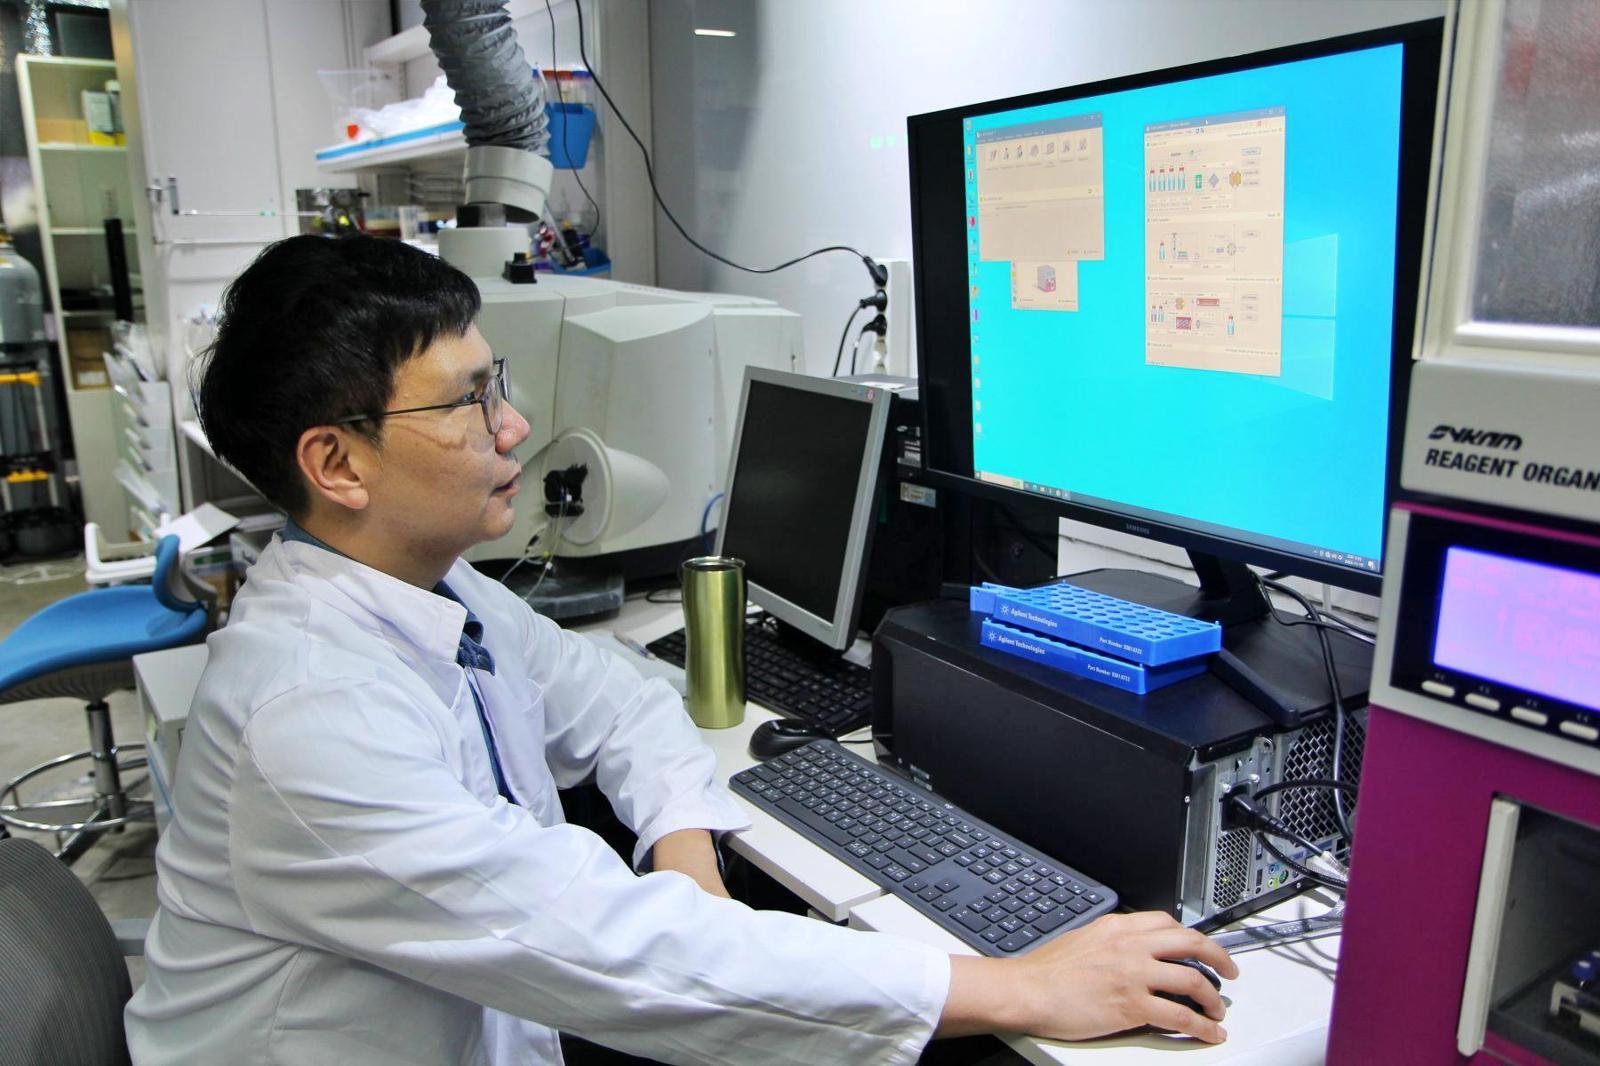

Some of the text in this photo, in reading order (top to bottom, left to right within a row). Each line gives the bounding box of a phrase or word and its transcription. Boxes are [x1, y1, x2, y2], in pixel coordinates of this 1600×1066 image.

[1425, 448, 1600, 491] REAGENT ORGAN
[1011, 608, 1058, 628] Agilent Technologies
[998, 635, 1045, 654] Agilent Technologies
[1107, 639, 1123, 648] Number
[1096, 666, 1111, 676] Number
